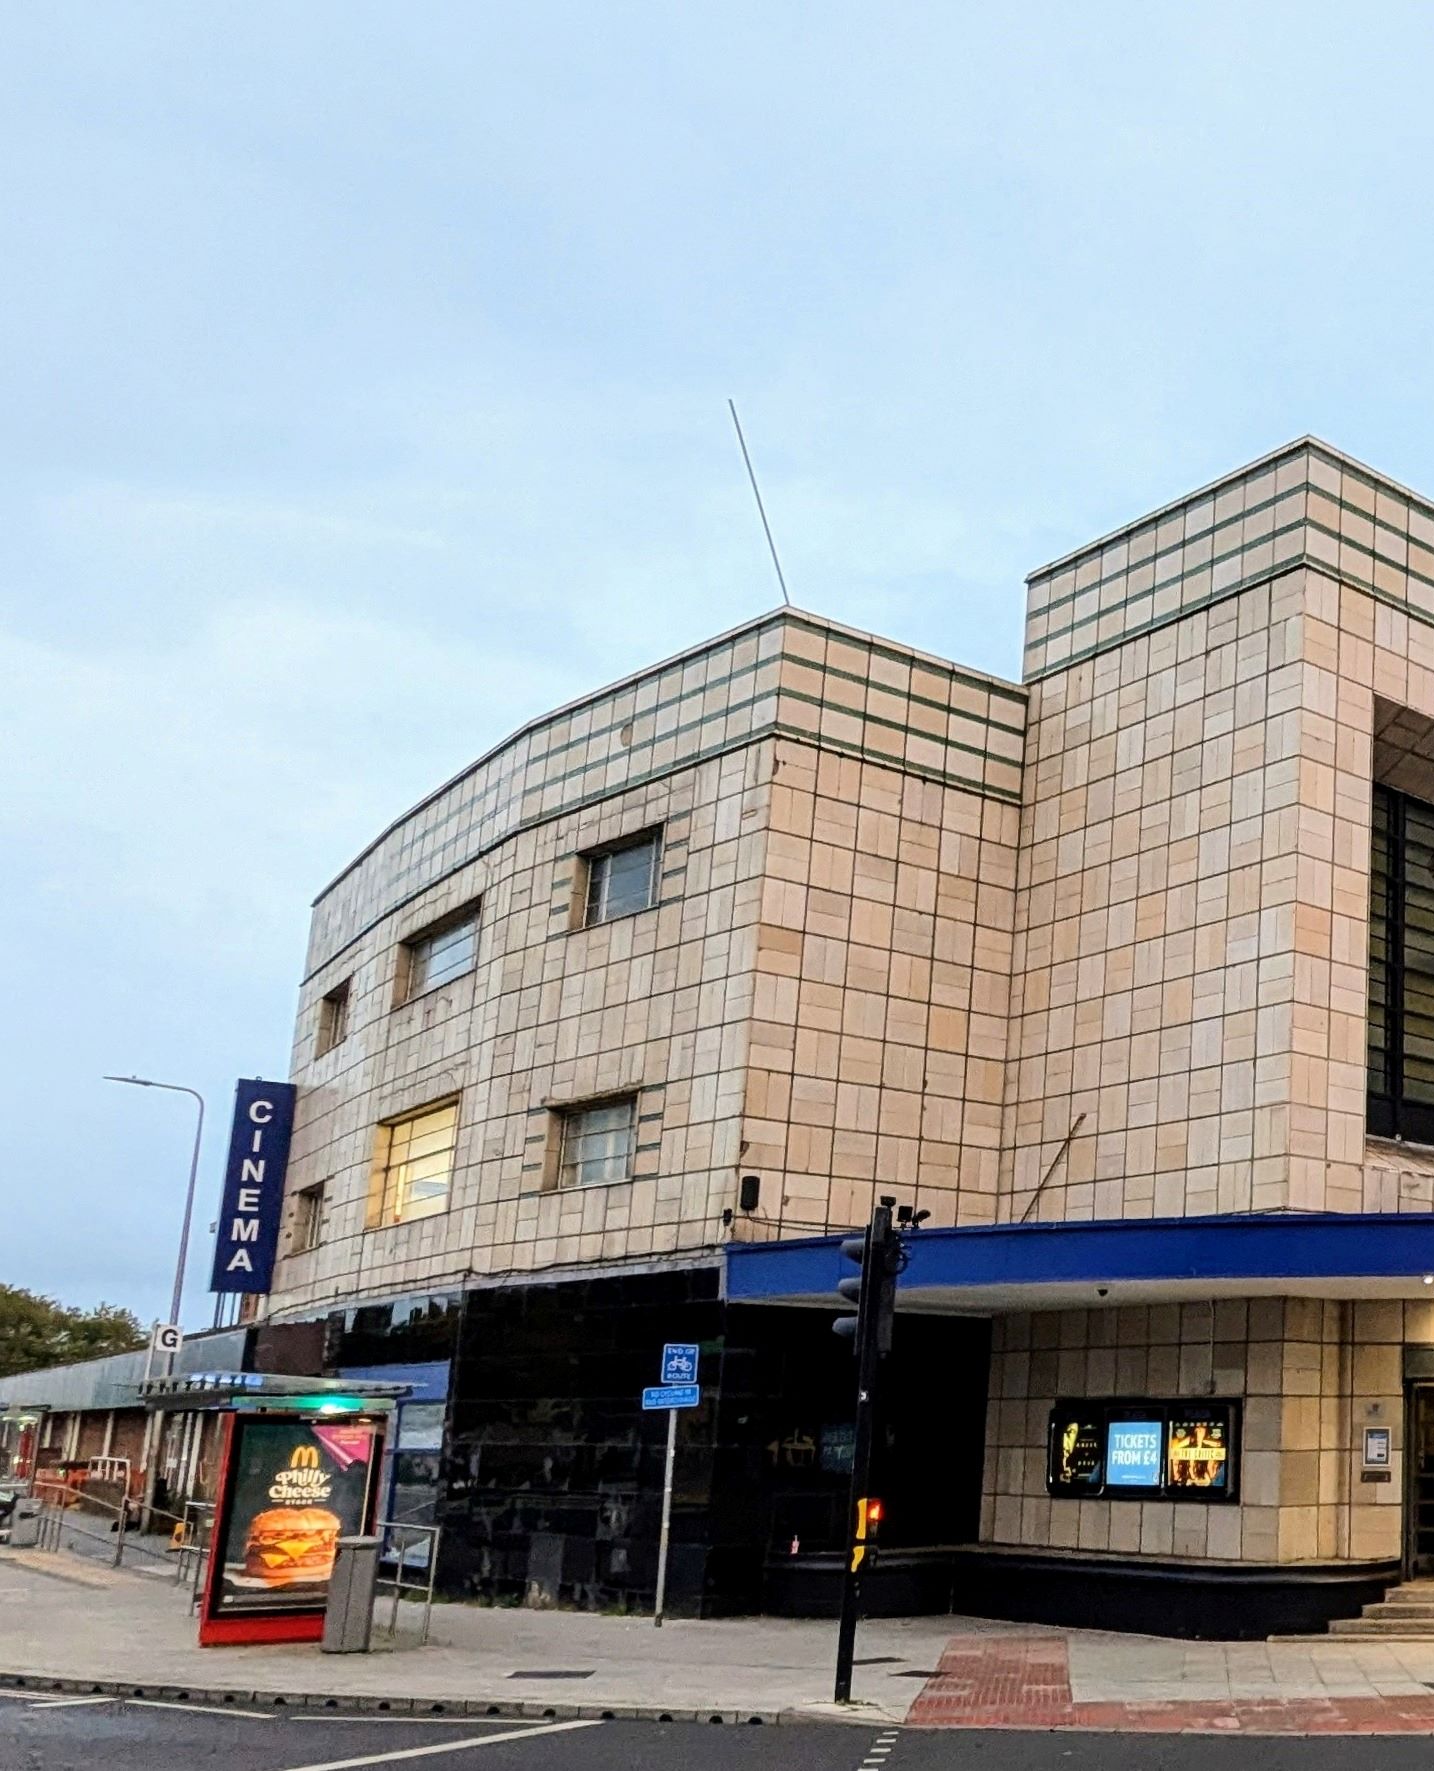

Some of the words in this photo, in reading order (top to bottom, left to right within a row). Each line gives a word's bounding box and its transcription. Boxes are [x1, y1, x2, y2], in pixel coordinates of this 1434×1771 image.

[226, 1100, 274, 1272] CINEMA
[161, 1328, 179, 1348] G
[1113, 1433, 1157, 1449] TICKETS
[1112, 1450, 1141, 1466] FROM
[1143, 1450, 1158, 1466] £4
[274, 1468, 332, 1487] Philly
[268, 1485, 332, 1499] Cheese
